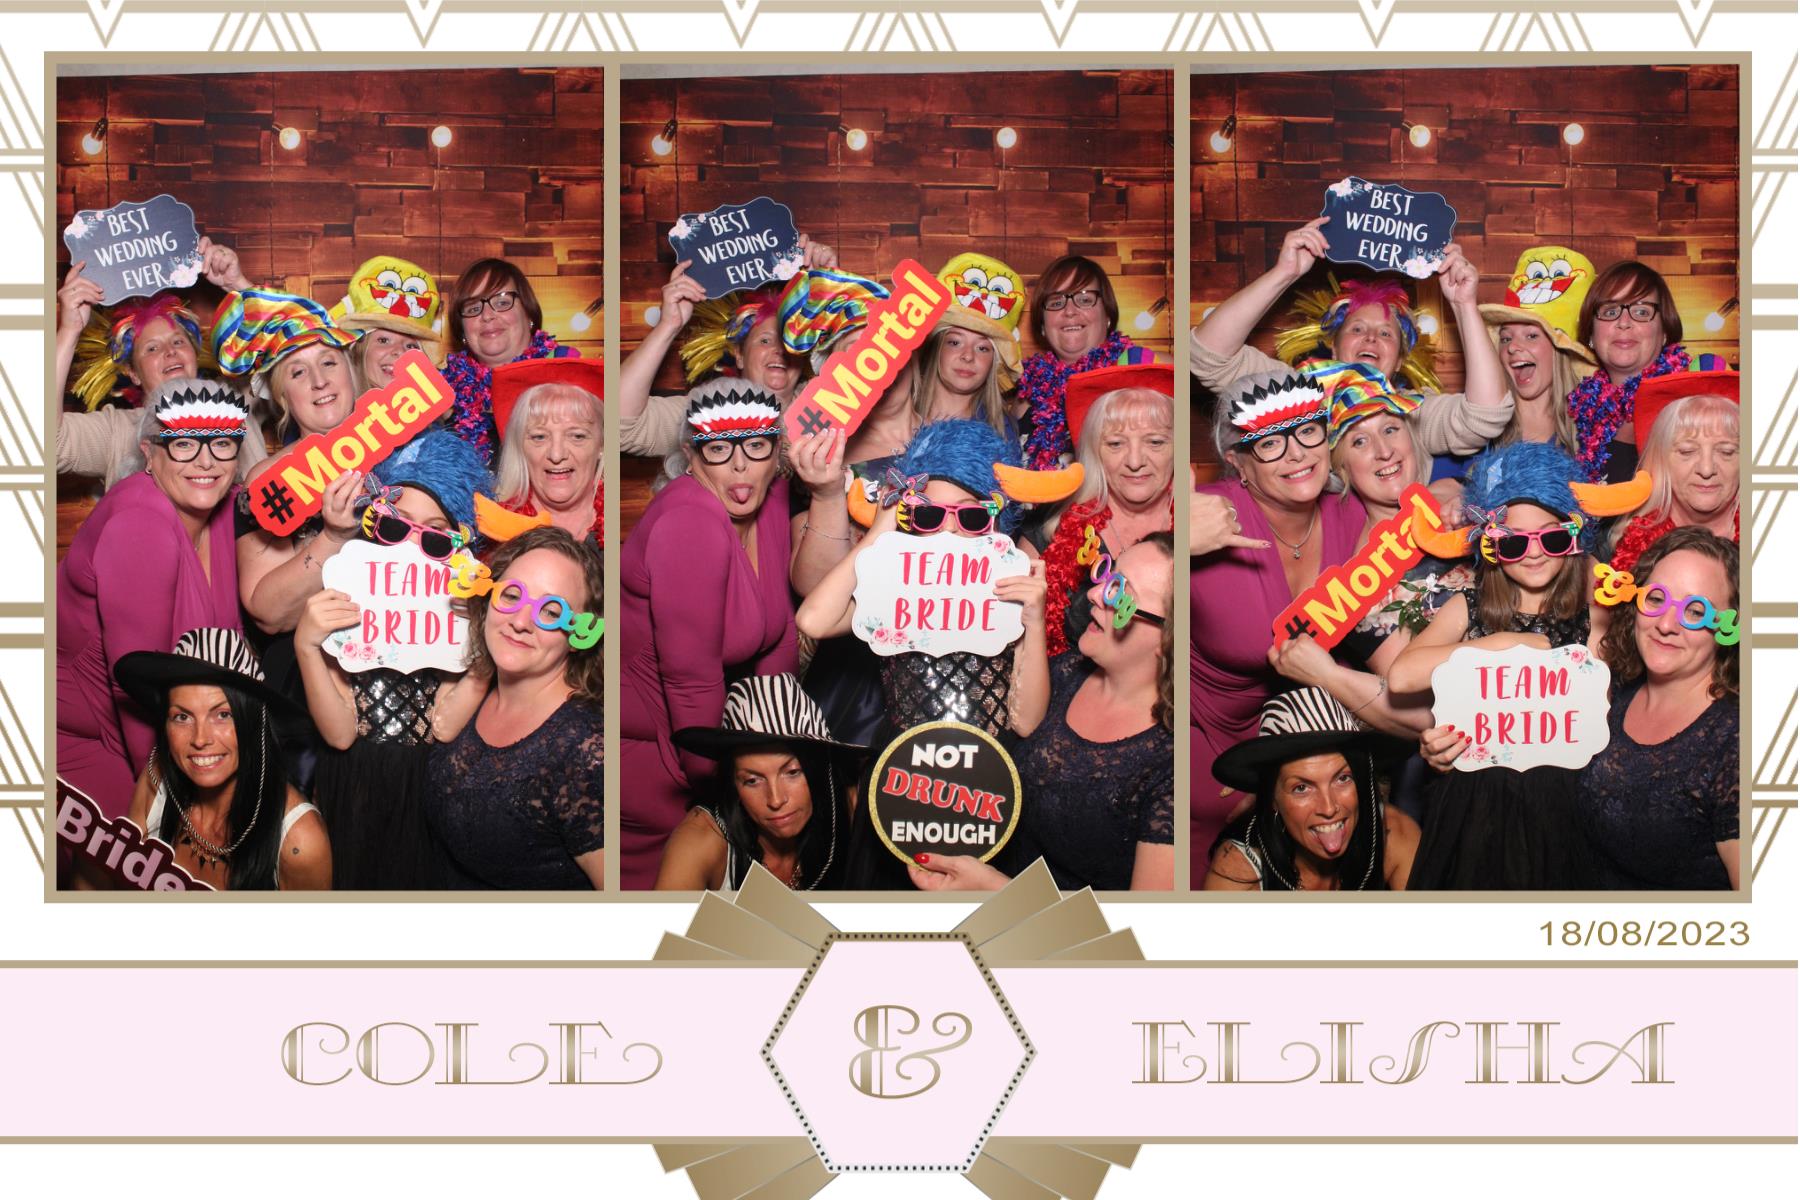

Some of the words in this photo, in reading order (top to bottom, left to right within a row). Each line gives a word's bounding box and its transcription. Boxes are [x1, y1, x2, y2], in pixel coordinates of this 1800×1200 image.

[1370, 189, 1414, 216] BEST
[107, 207, 150, 236] BEST
[709, 208, 750, 236] BEST
[1346, 211, 1428, 242] WEDDING
[94, 231, 178, 267] WEDDING
[698, 229, 778, 264] WEDDING
[1358, 239, 1402, 268] EVER
[122, 263, 170, 290] EVER
[726, 258, 772, 284] EVER
[261, 362, 443, 525] #Mortal
[365, 561, 451, 598] TEAM
[899, 551, 992, 586] TEAM
[362, 609, 461, 646] BRIDE
[894, 597, 998, 632] BRIDE
[1475, 665, 1571, 700] TEAM
[1475, 710, 1580, 745] BRIDE
[911, 743, 979, 769] NOT
[882, 767, 1006, 823] DRUNK
[891, 820, 996, 845] ENOUGH
